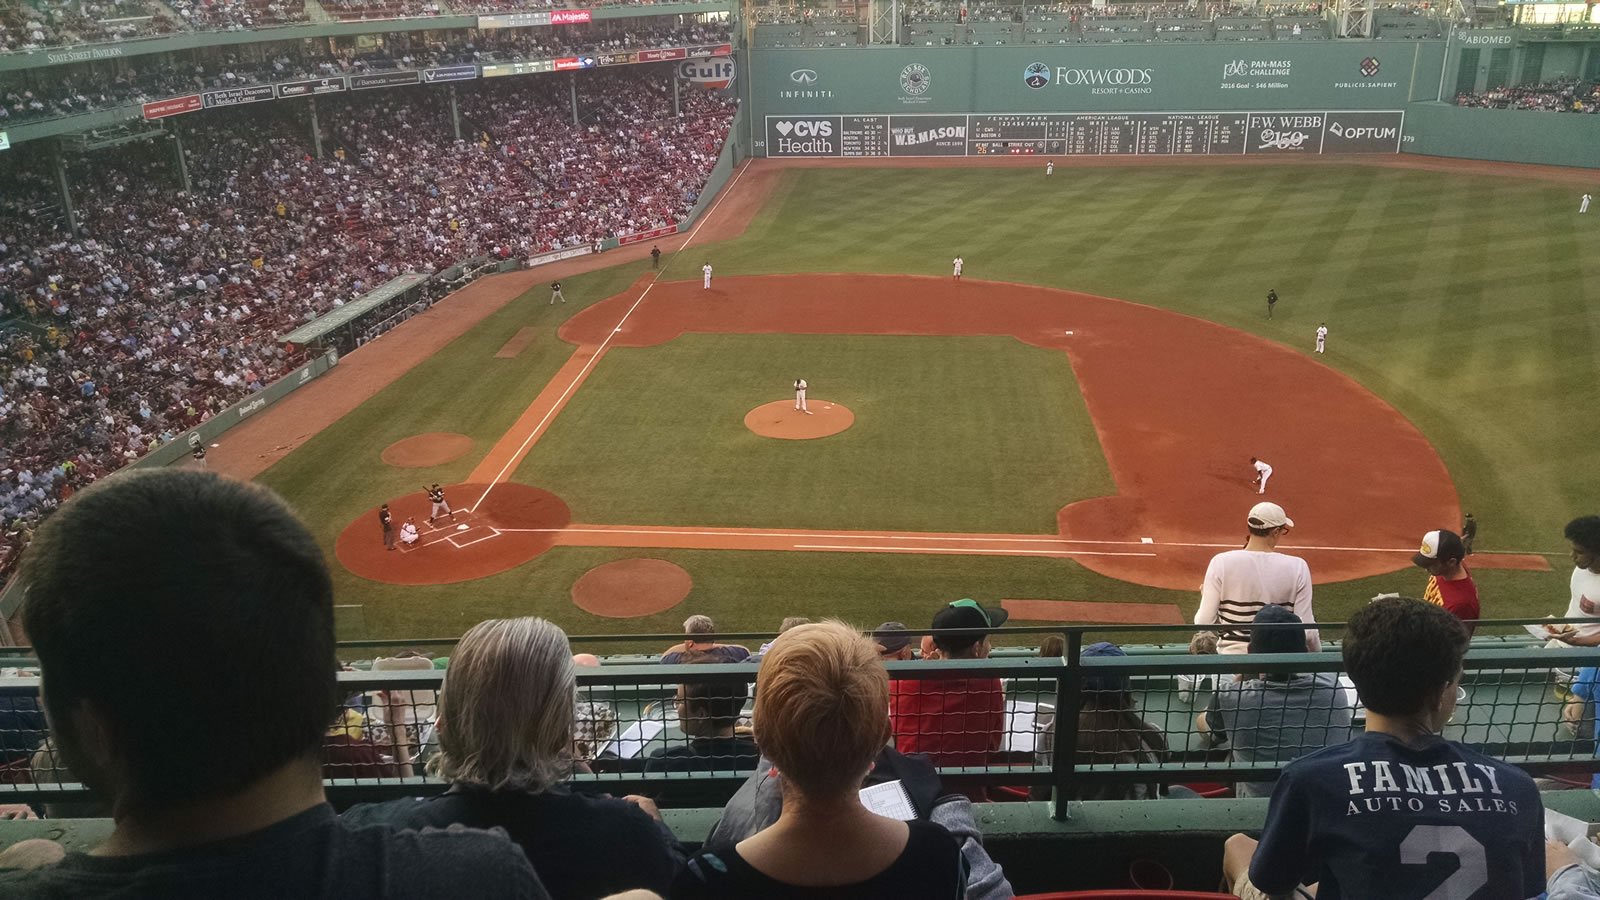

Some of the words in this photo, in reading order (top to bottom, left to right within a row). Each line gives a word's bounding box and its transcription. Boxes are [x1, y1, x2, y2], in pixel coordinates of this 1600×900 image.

[562, 12, 589, 23] Majestic
[1465, 35, 1512, 44] ABIOMED
[47, 53, 68, 63] STATE
[69, 50, 91, 61] STREET
[92, 47, 122, 59] PAVILION
[680, 60, 733, 78] Gulf
[1251, 60, 1291, 68] PAN-MASS
[1055, 66, 1152, 85] FOXWOODS
[214, 92, 227, 100] Beth
[244, 87, 271, 96] Deaconess
[780, 90, 833, 98] INFINITI
[1092, 87, 1117, 95] RESORT
[1124, 87, 1152, 95] CASINO
[215, 97, 237, 105] Medical
[794, 120, 833, 137] CVS
[1250, 116, 1276, 128] F.W.
[1280, 116, 1322, 128] WEBB
[1345, 127, 1396, 139] OPTUM
[778, 138, 833, 153] Health
[1343, 761, 1502, 796] FAMILY
[1346, 796, 1424, 816] AUTO
[1438, 797, 1518, 816] SALES
[1399, 825, 1489, 900] 2
